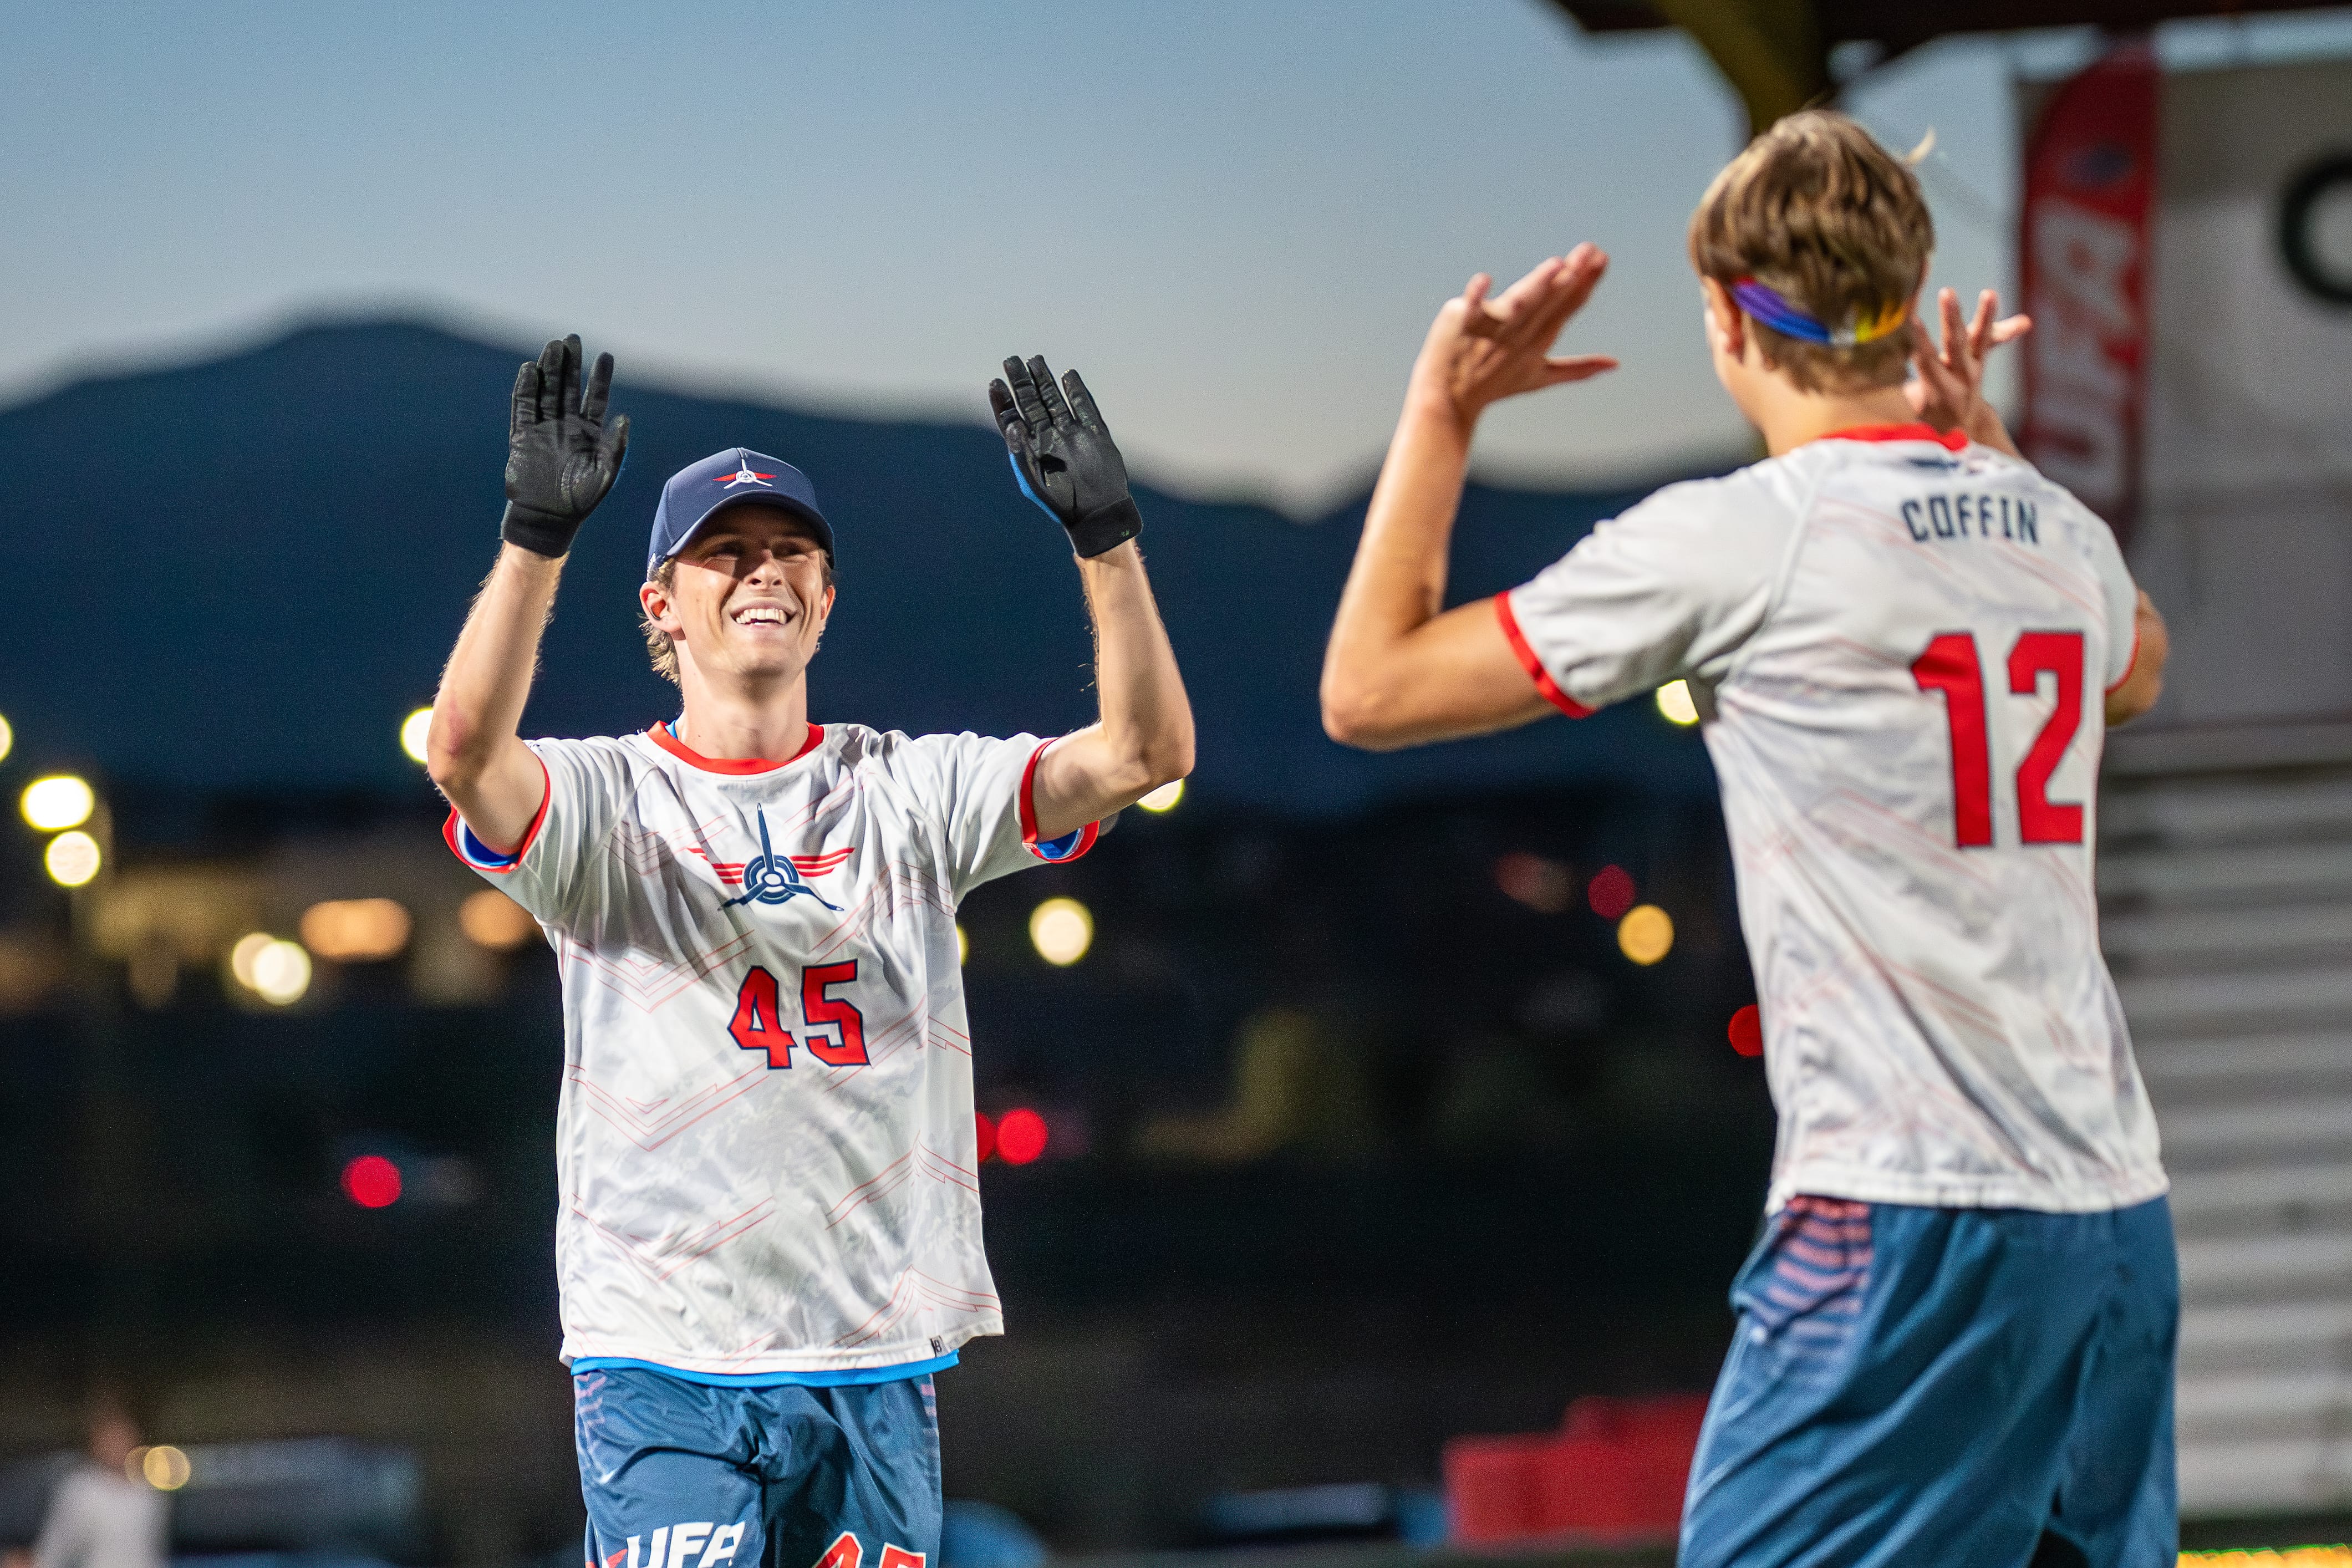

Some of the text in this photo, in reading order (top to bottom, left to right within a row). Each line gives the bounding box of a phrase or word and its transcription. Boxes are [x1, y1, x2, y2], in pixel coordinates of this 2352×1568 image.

[2029, 195, 2136, 503] UFA
[1900, 492, 2040, 543] COFFIN
[1911, 630, 2085, 848] 12
[727, 958, 870, 1070] 45
[626, 1521, 746, 1568] UFA
